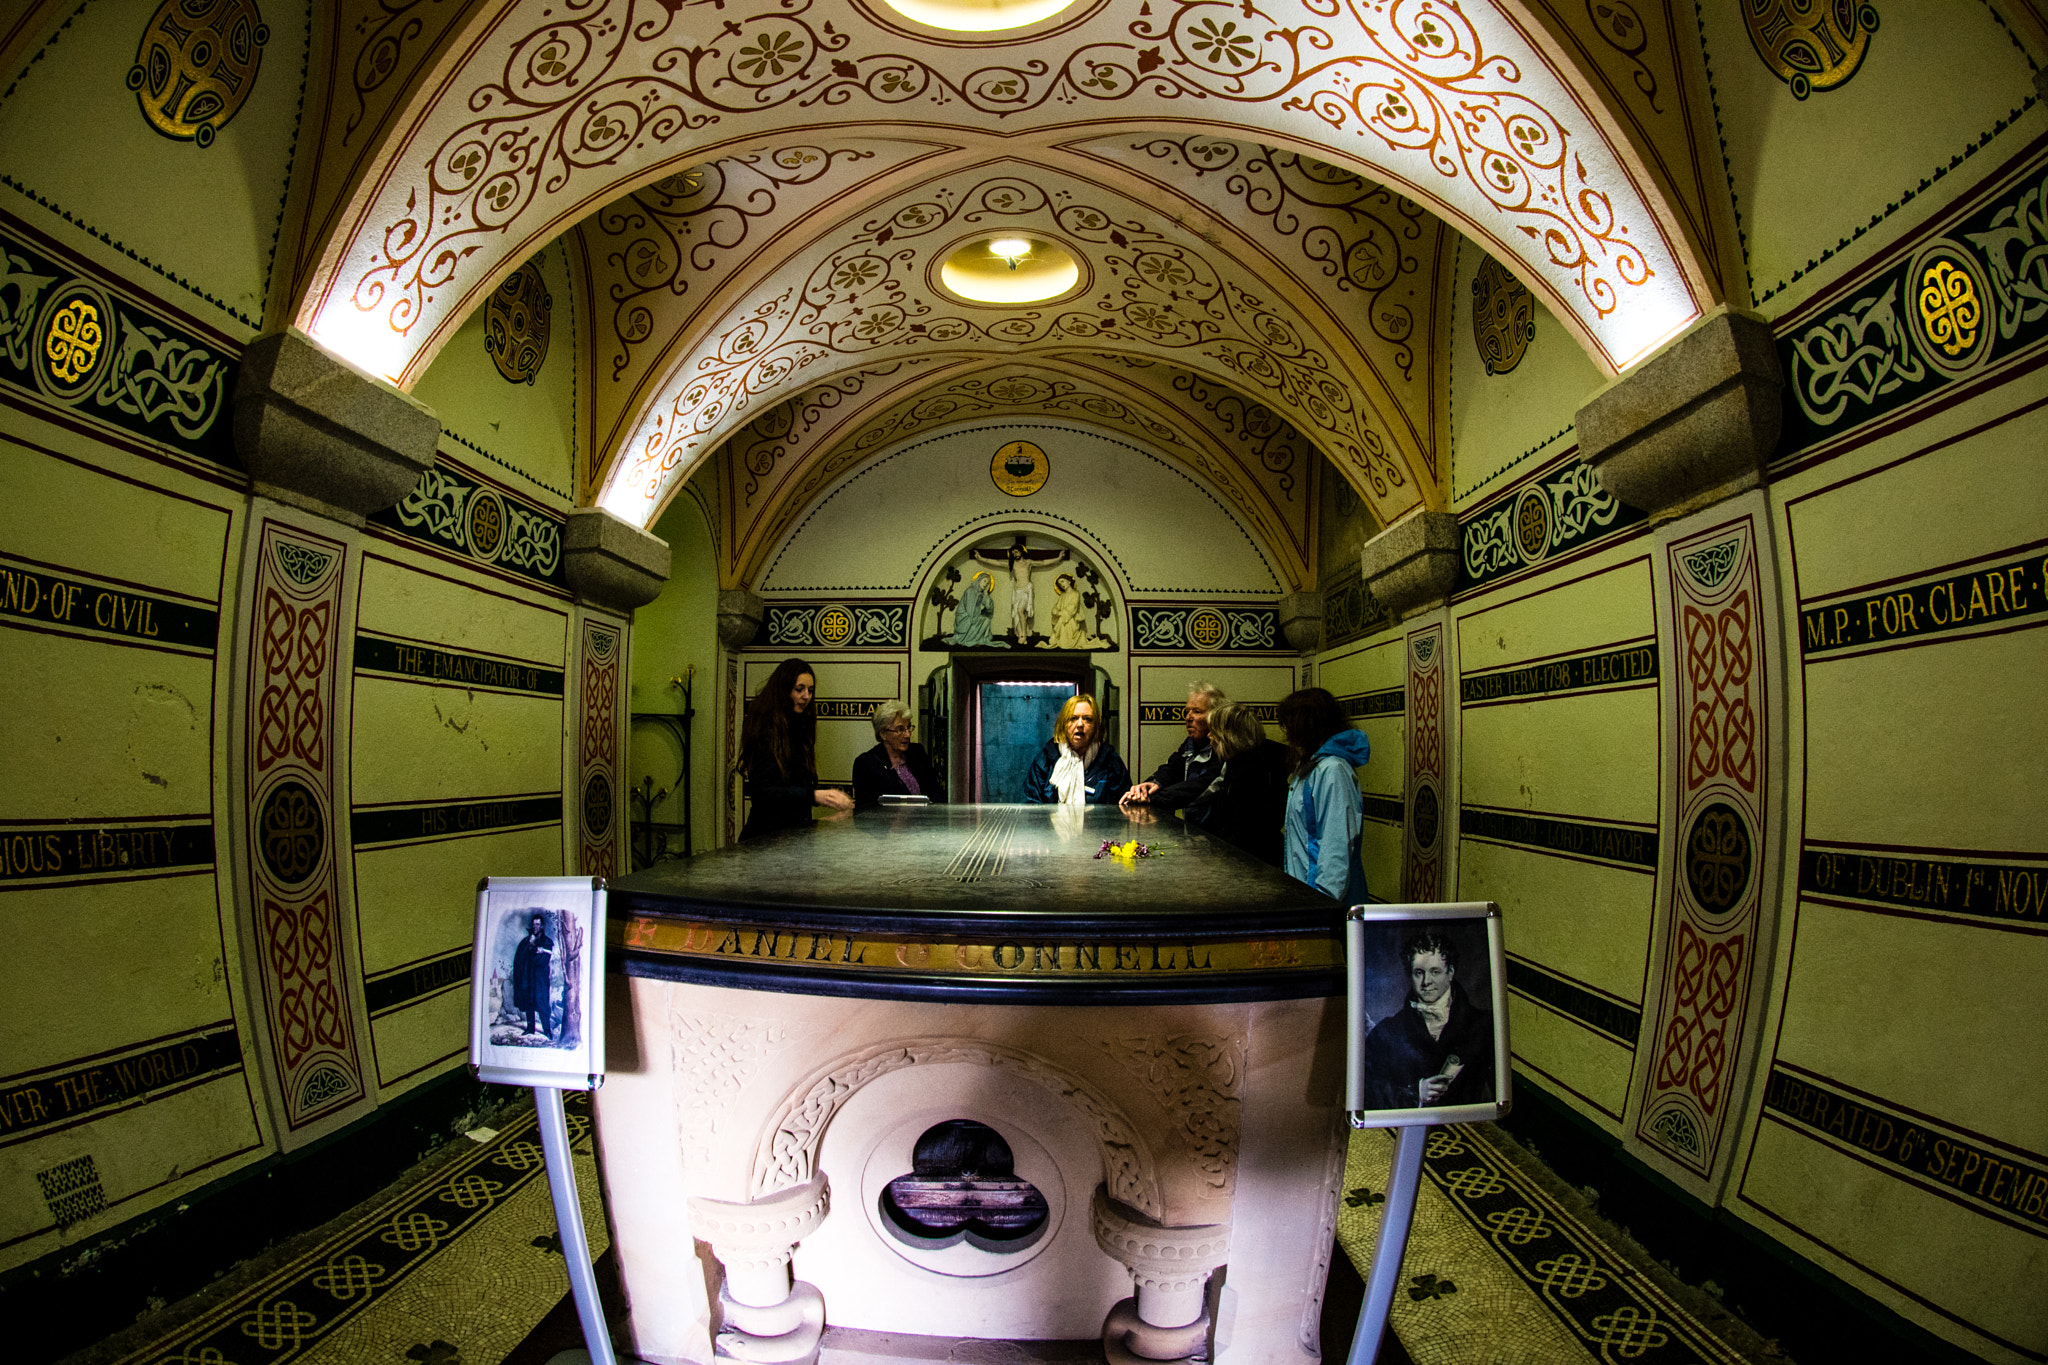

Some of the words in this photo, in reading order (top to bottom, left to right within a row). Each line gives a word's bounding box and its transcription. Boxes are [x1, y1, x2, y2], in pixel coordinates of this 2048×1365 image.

[51, 582, 82, 621] OF
[95, 592, 159, 637] CIVIL
[1805, 608, 1852, 649] M.P.
[1866, 593, 1920, 639] FOR
[1929, 566, 2028, 626] CLARE
[395, 645, 426, 675] THE
[433, 652, 521, 688] EMANCIPATOR
[526, 669, 541, 690] OF
[1463, 674, 1504, 700] EASTER
[1506, 668, 1540, 694] TERM
[1543, 662, 1571, 690] 1798
[1582, 648, 1654, 685] ELECTED
[836, 702, 880, 716] IRELA
[1142, 706, 1165, 721] MY
[421, 809, 448, 834] HIS
[457, 803, 519, 830] CATHOLIC
[1547, 822, 1584, 850] LORD
[1591, 829, 1644, 860] MAYOR
[0, 835, 62, 875] IOUS
[76, 831, 175, 869] LIBERTY
[1816, 852, 1846, 889] OF
[1857, 856, 1951, 904] DUBLIN
[1961, 867, 1985, 907] 1st
[54, 1070, 107, 1112] THE
[114, 1045, 200, 1094] WORLD
[1767, 1073, 1894, 1152] LIBERATED
